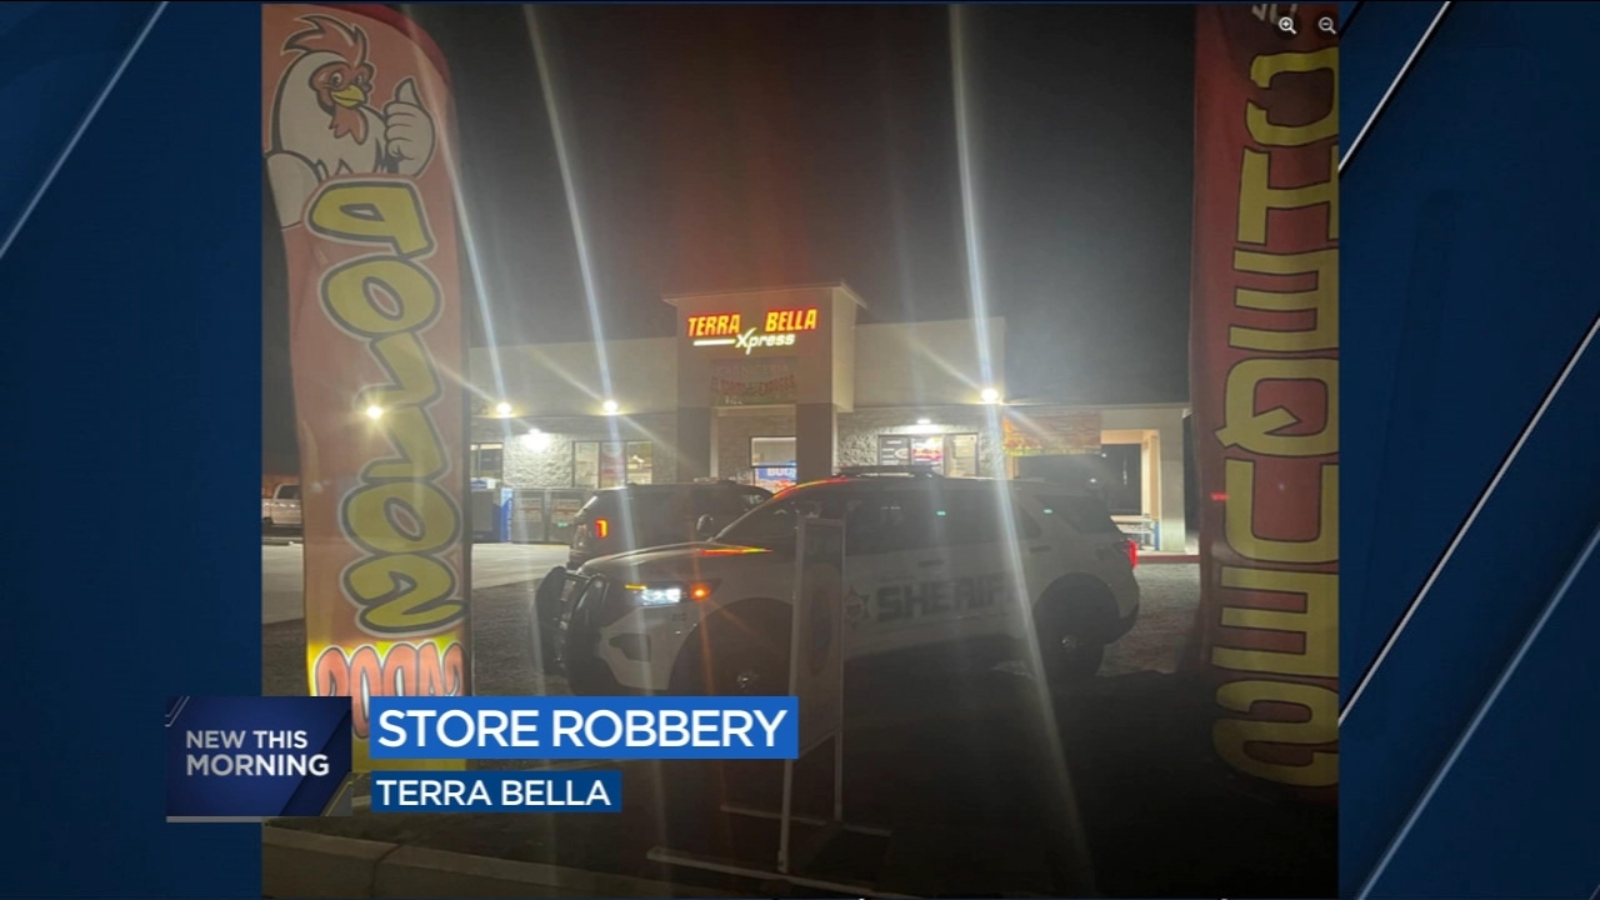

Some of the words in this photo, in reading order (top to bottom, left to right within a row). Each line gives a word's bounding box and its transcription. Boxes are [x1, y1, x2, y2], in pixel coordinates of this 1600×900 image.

[687, 313, 741, 337] TERRA
[763, 308, 819, 333] BELLA
[734, 327, 796, 356] Xpress
